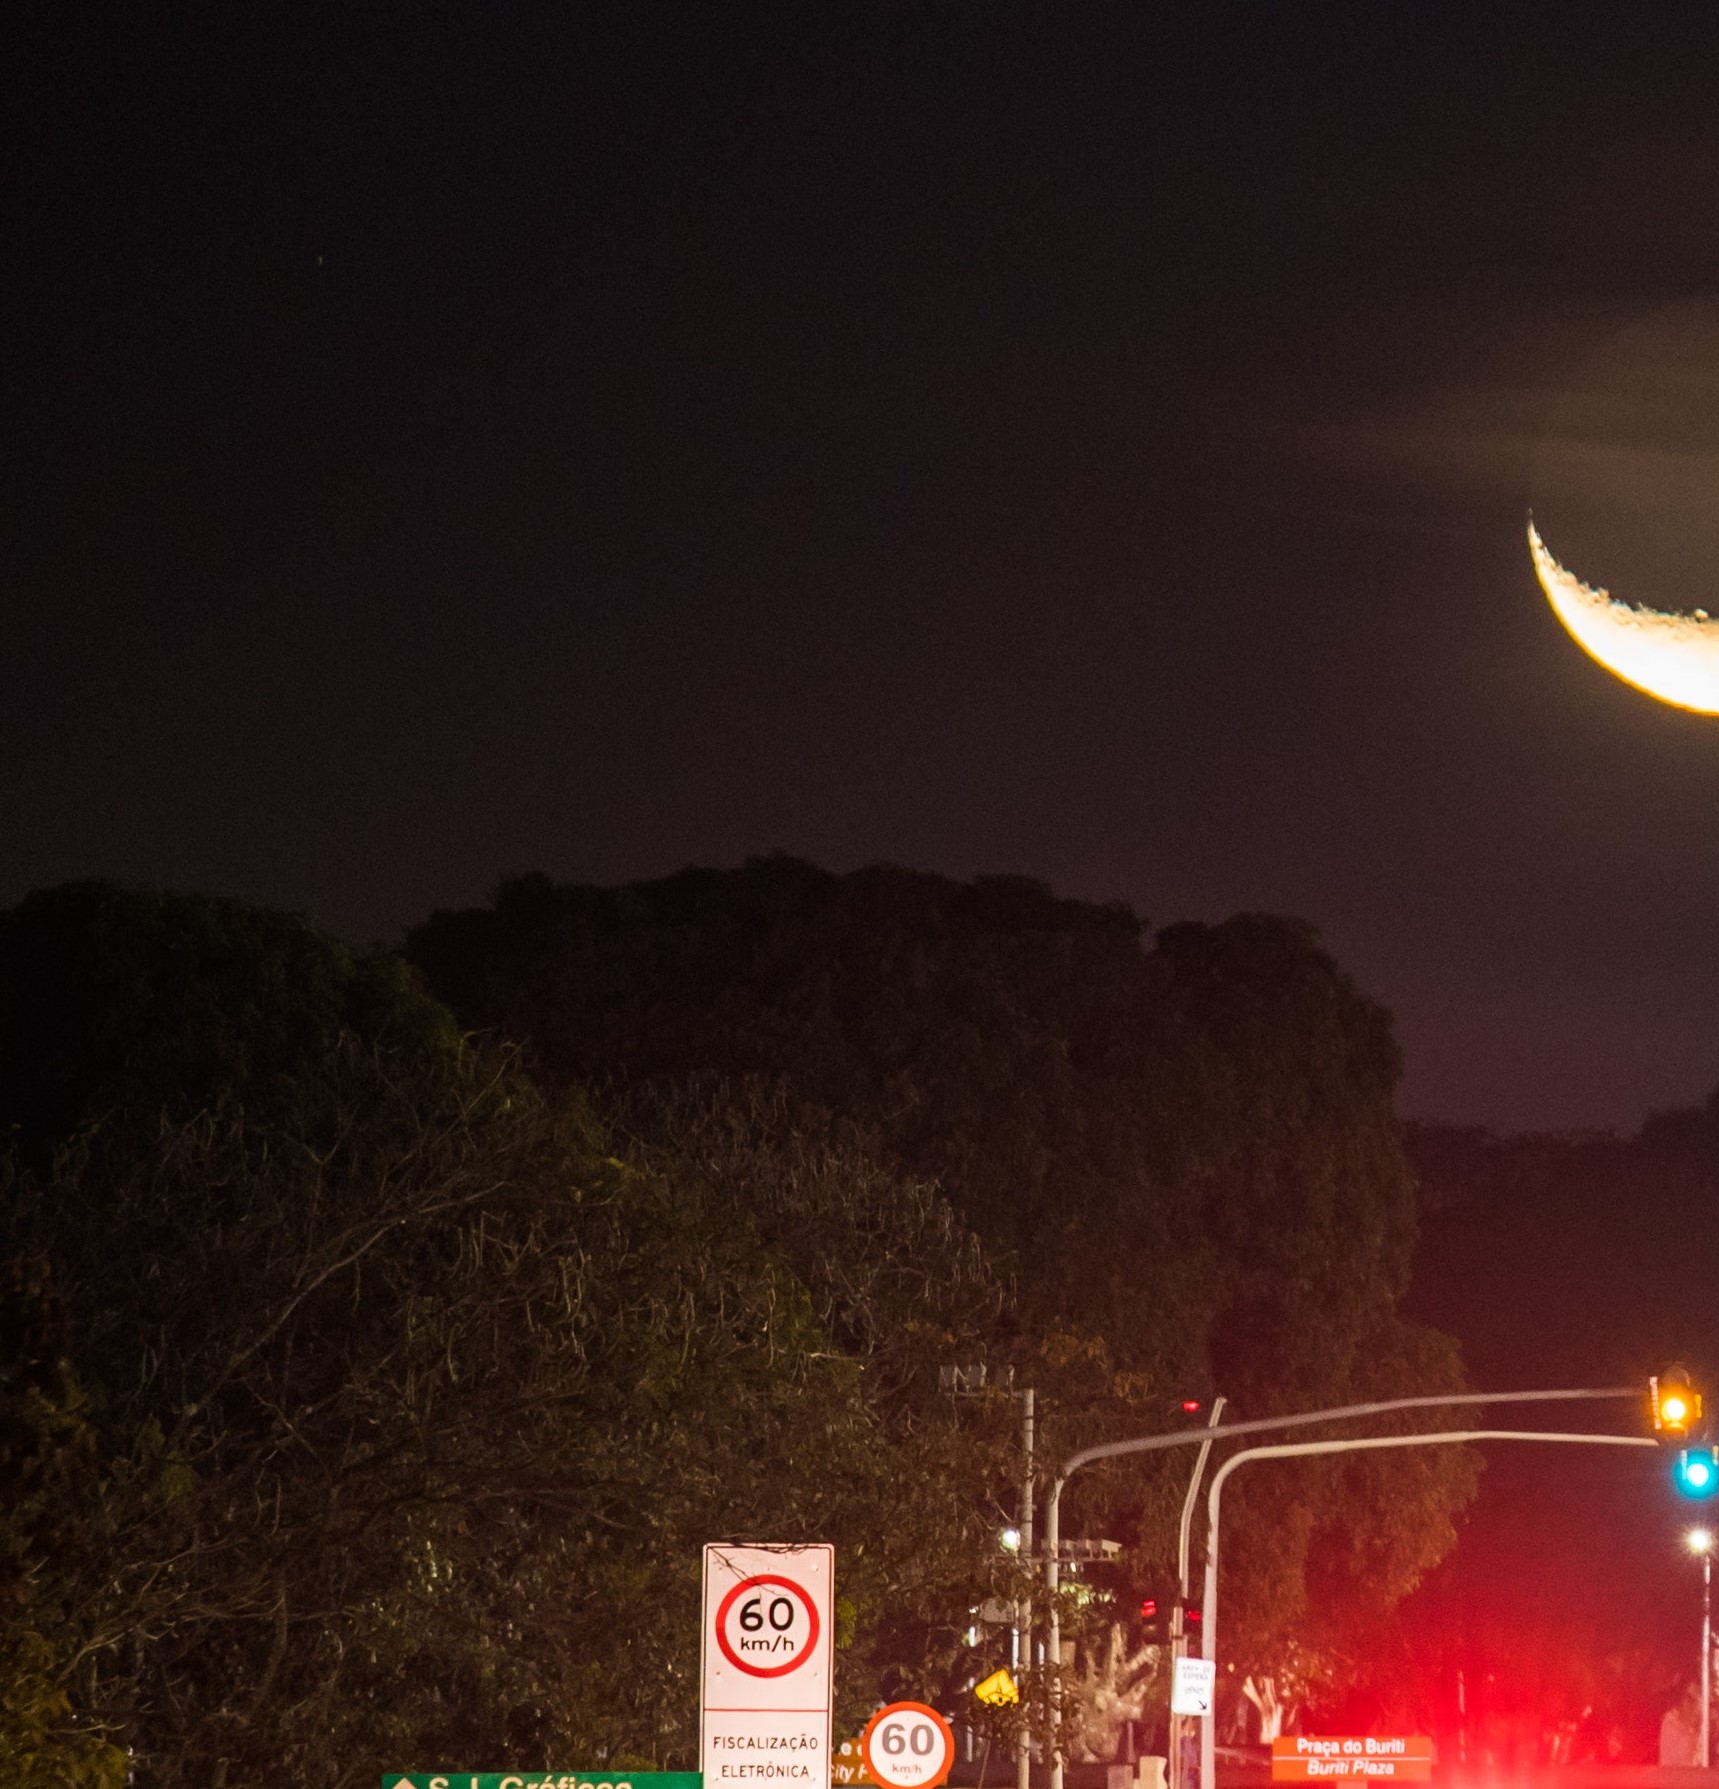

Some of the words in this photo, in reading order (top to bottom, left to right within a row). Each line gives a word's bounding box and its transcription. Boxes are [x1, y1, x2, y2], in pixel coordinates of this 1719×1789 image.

[740, 1597, 795, 1632] 60
[741, 1635, 794, 1652] km/h
[713, 1734, 818, 1752] FISCALIZAÇÃO
[881, 1723, 935, 1756] 60
[1297, 1738, 1340, 1759] Praça
[1343, 1739, 1362, 1754] do
[1365, 1738, 1405, 1754] Buriti
[722, 1760, 809, 1778] ELETRÔNICA
[831, 1764, 855, 1783] ity
[892, 1763, 923, 1774] km/h
[1307, 1759, 1349, 1775] Buriti
[1353, 1759, 1394, 1775] Plaza
